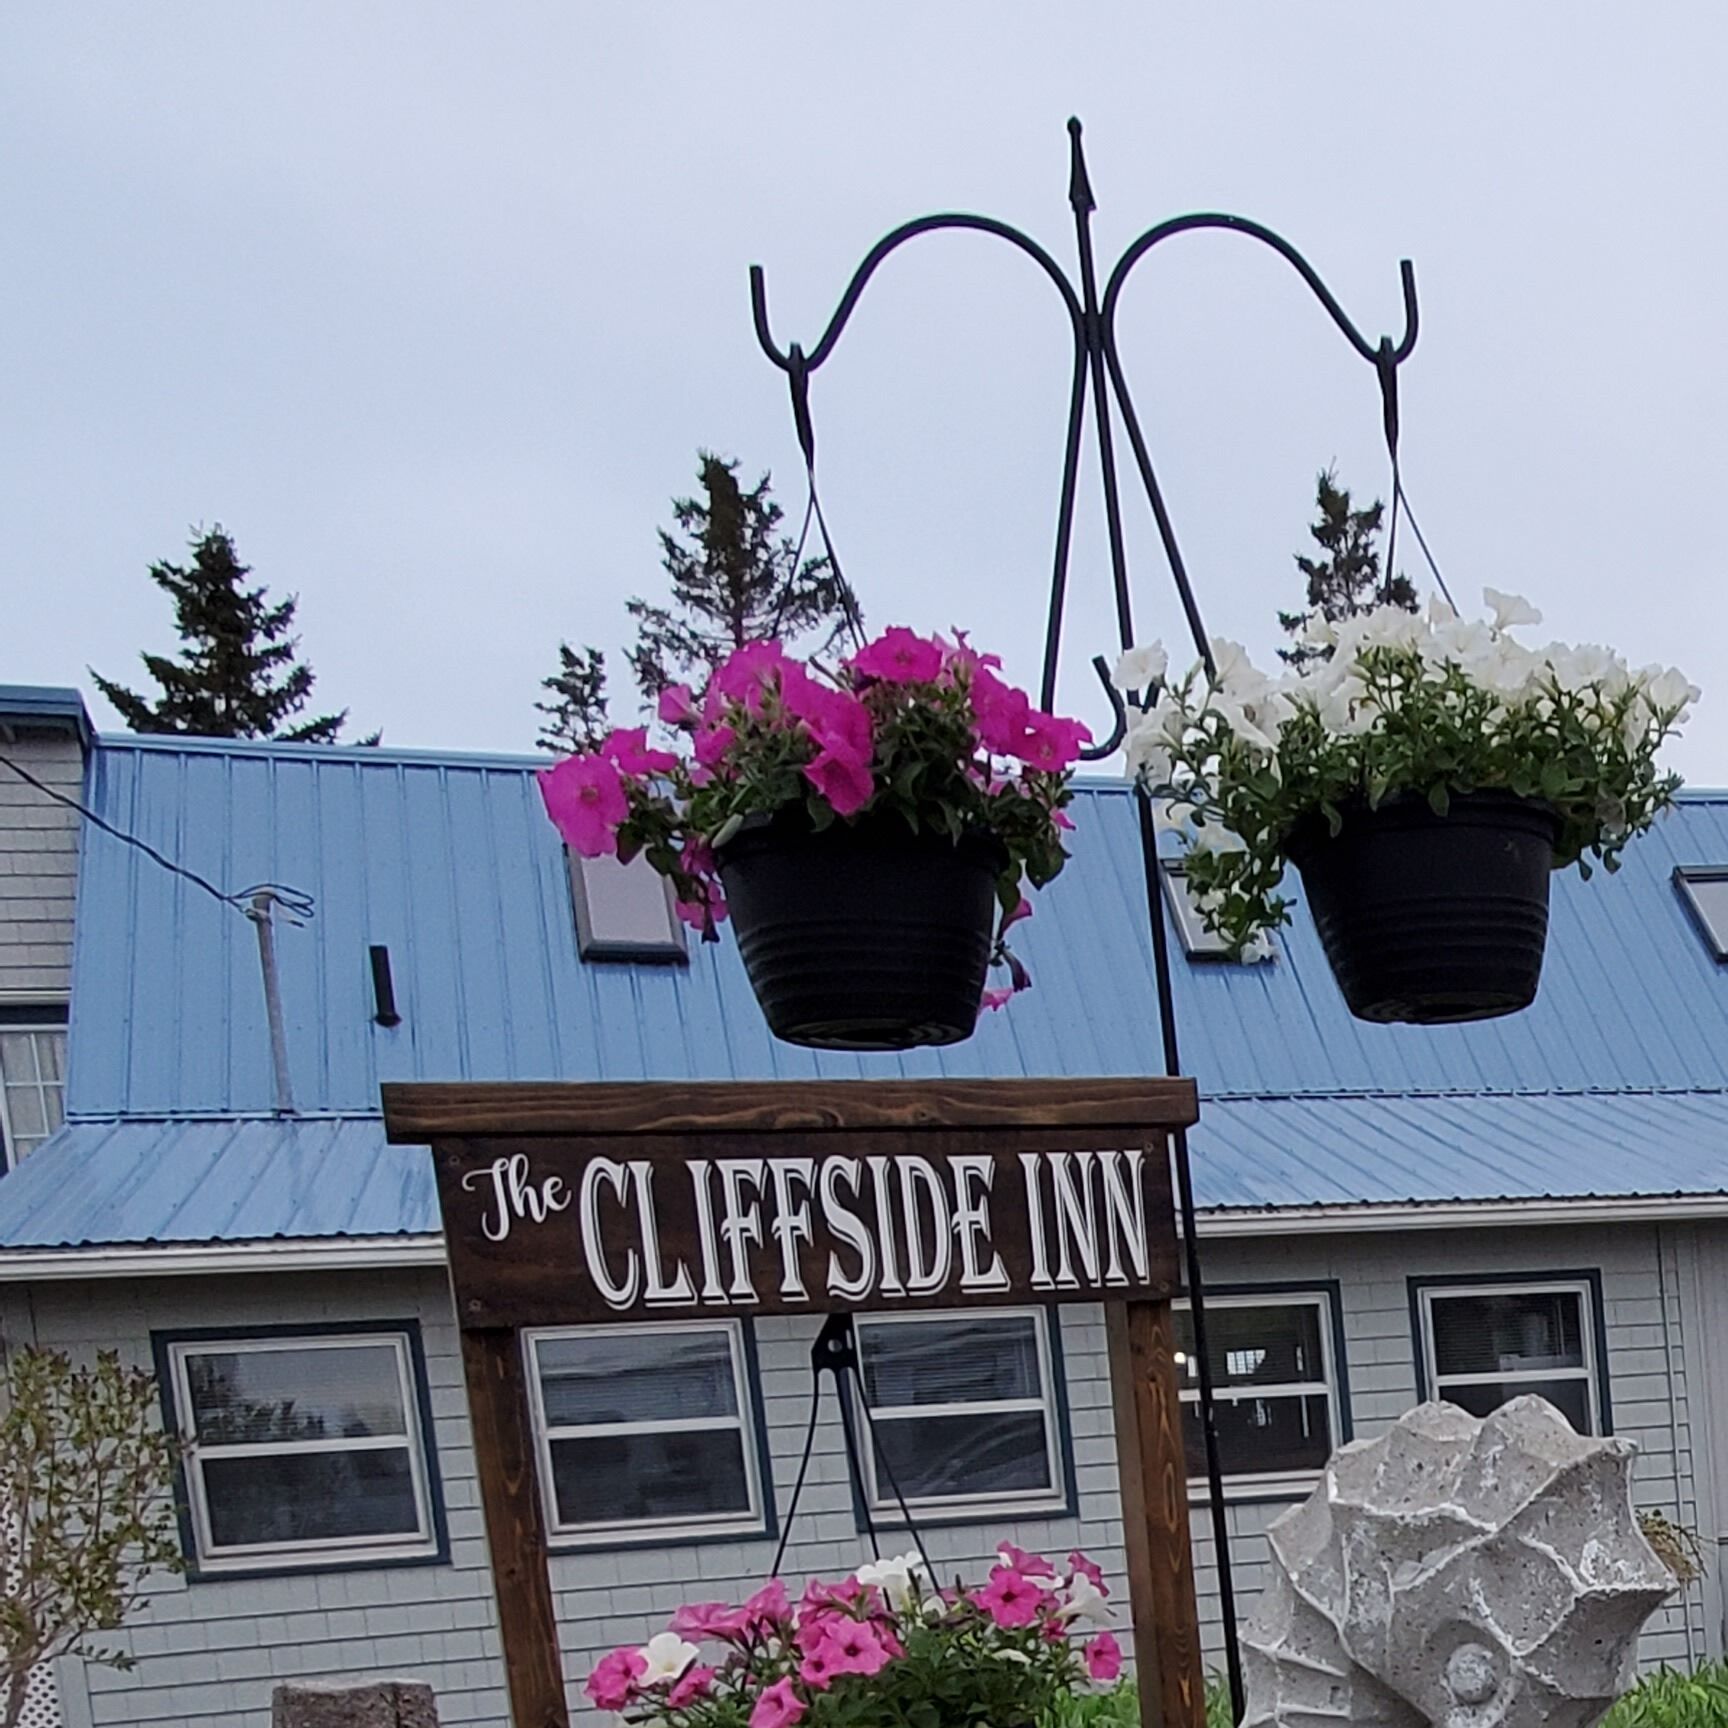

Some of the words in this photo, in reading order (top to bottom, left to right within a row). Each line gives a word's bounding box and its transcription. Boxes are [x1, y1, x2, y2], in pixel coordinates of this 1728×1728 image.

[462, 1153, 571, 1241] The
[580, 1155, 1010, 1310] CLIFFSIDE
[1018, 1150, 1149, 1290] INN
